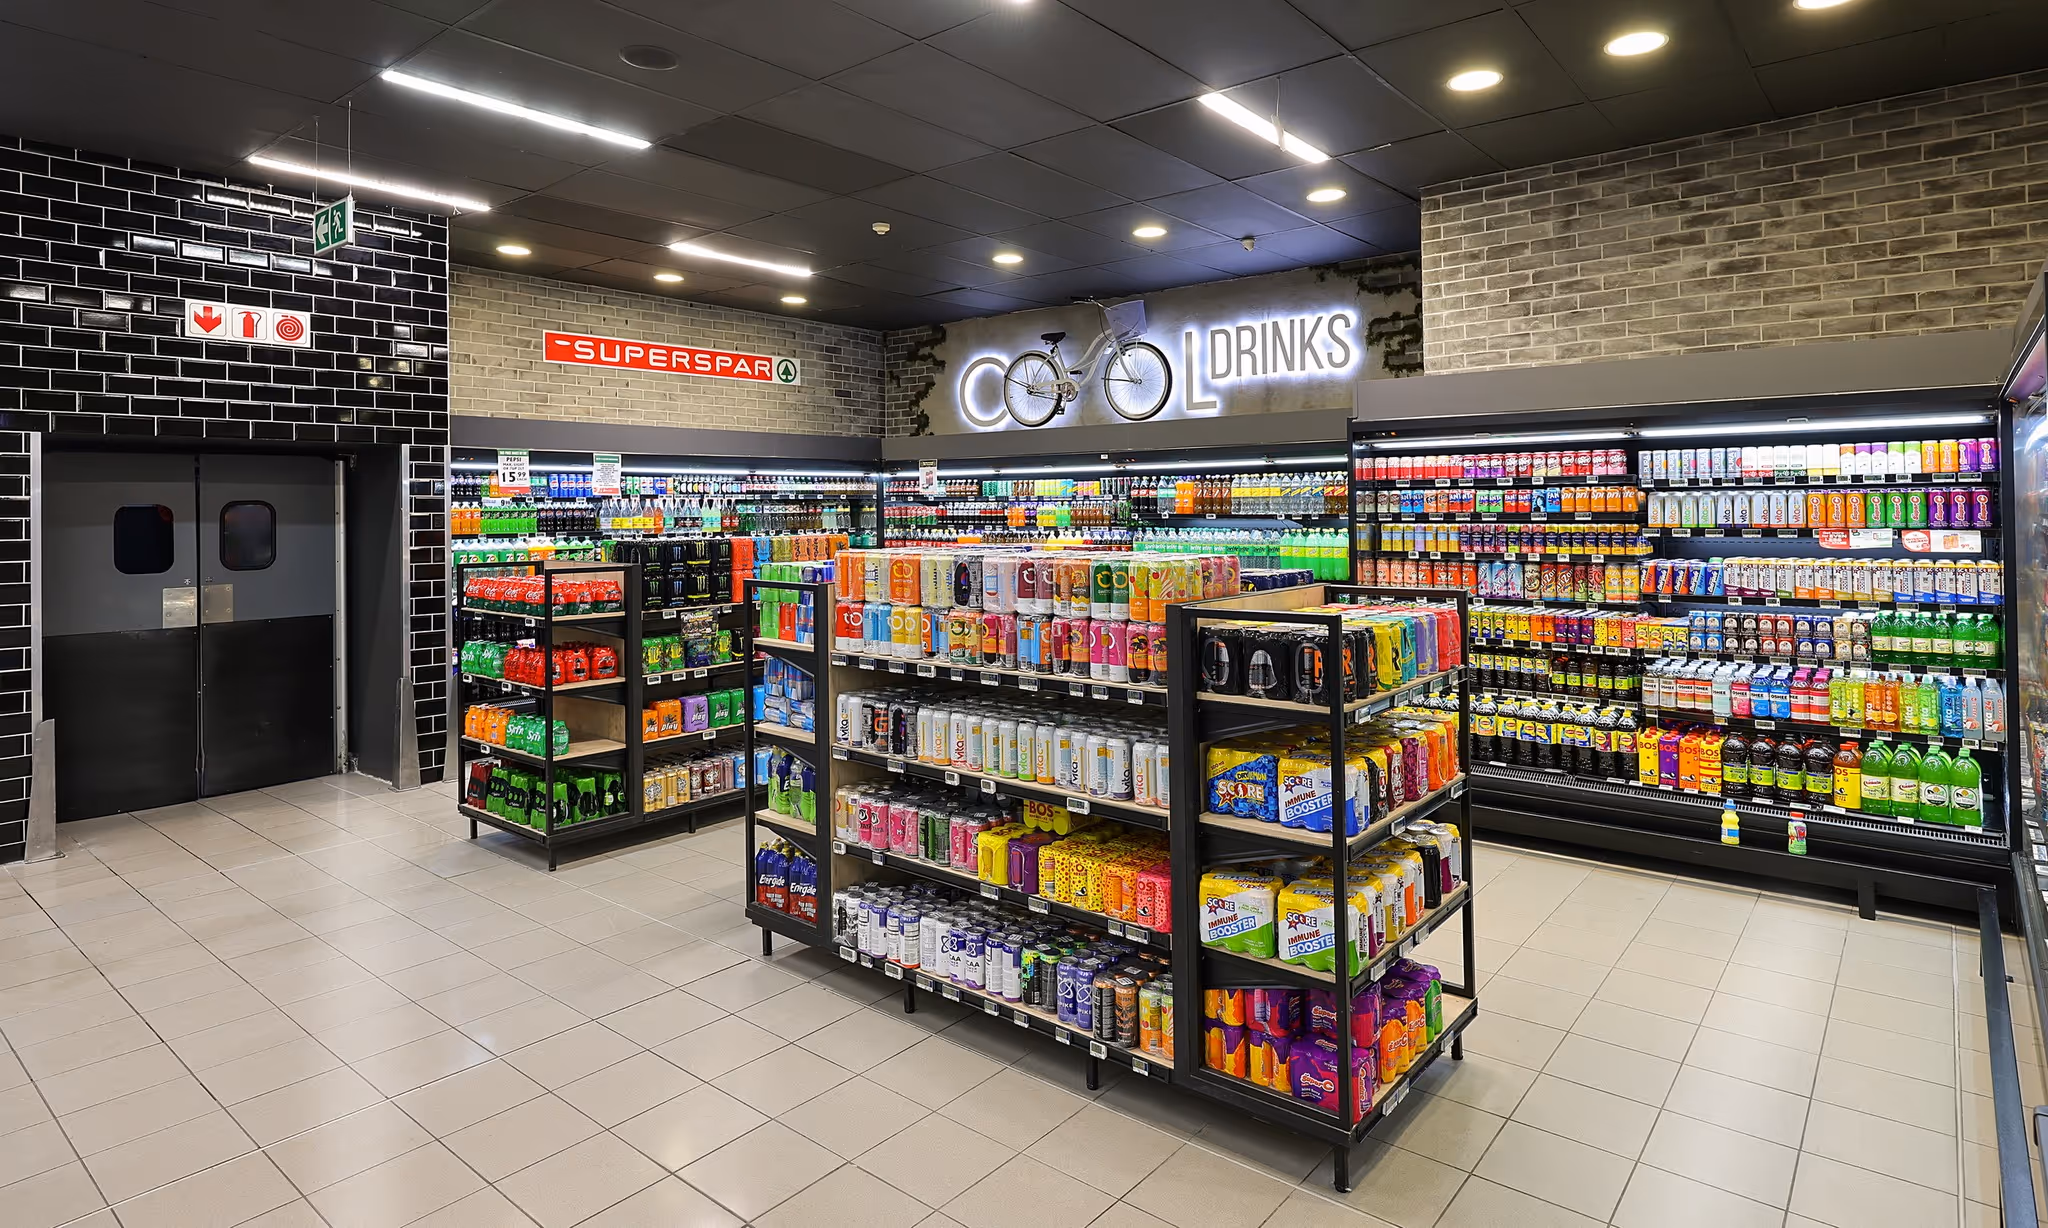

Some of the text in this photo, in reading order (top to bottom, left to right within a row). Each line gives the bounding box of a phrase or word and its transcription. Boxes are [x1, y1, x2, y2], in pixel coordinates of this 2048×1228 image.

[1210, 313, 1352, 380] DRINKS
[573, 340, 772, 378] SUPERSPAR
[502, 472, 515, 482] 15
[1640, 742, 1657, 750] BOS
[1680, 746, 1699, 754] BOS
[1700, 748, 1719, 756] BOS
[1217, 779, 1264, 801] SCORE
[1284, 776, 1313, 789] SCORE
[1285, 790, 1316, 807] IMMUNE
[1029, 801, 1054, 817] BOS
[1207, 897, 1235, 912] SCORE
[1208, 913, 1238, 929] IMMUNE
[1286, 912, 1317, 927] SCORE
[1209, 916, 1256, 940] BOOSTER
[1288, 929, 1320, 945] IMMUNE
[1289, 934, 1335, 957] BOOSTE
